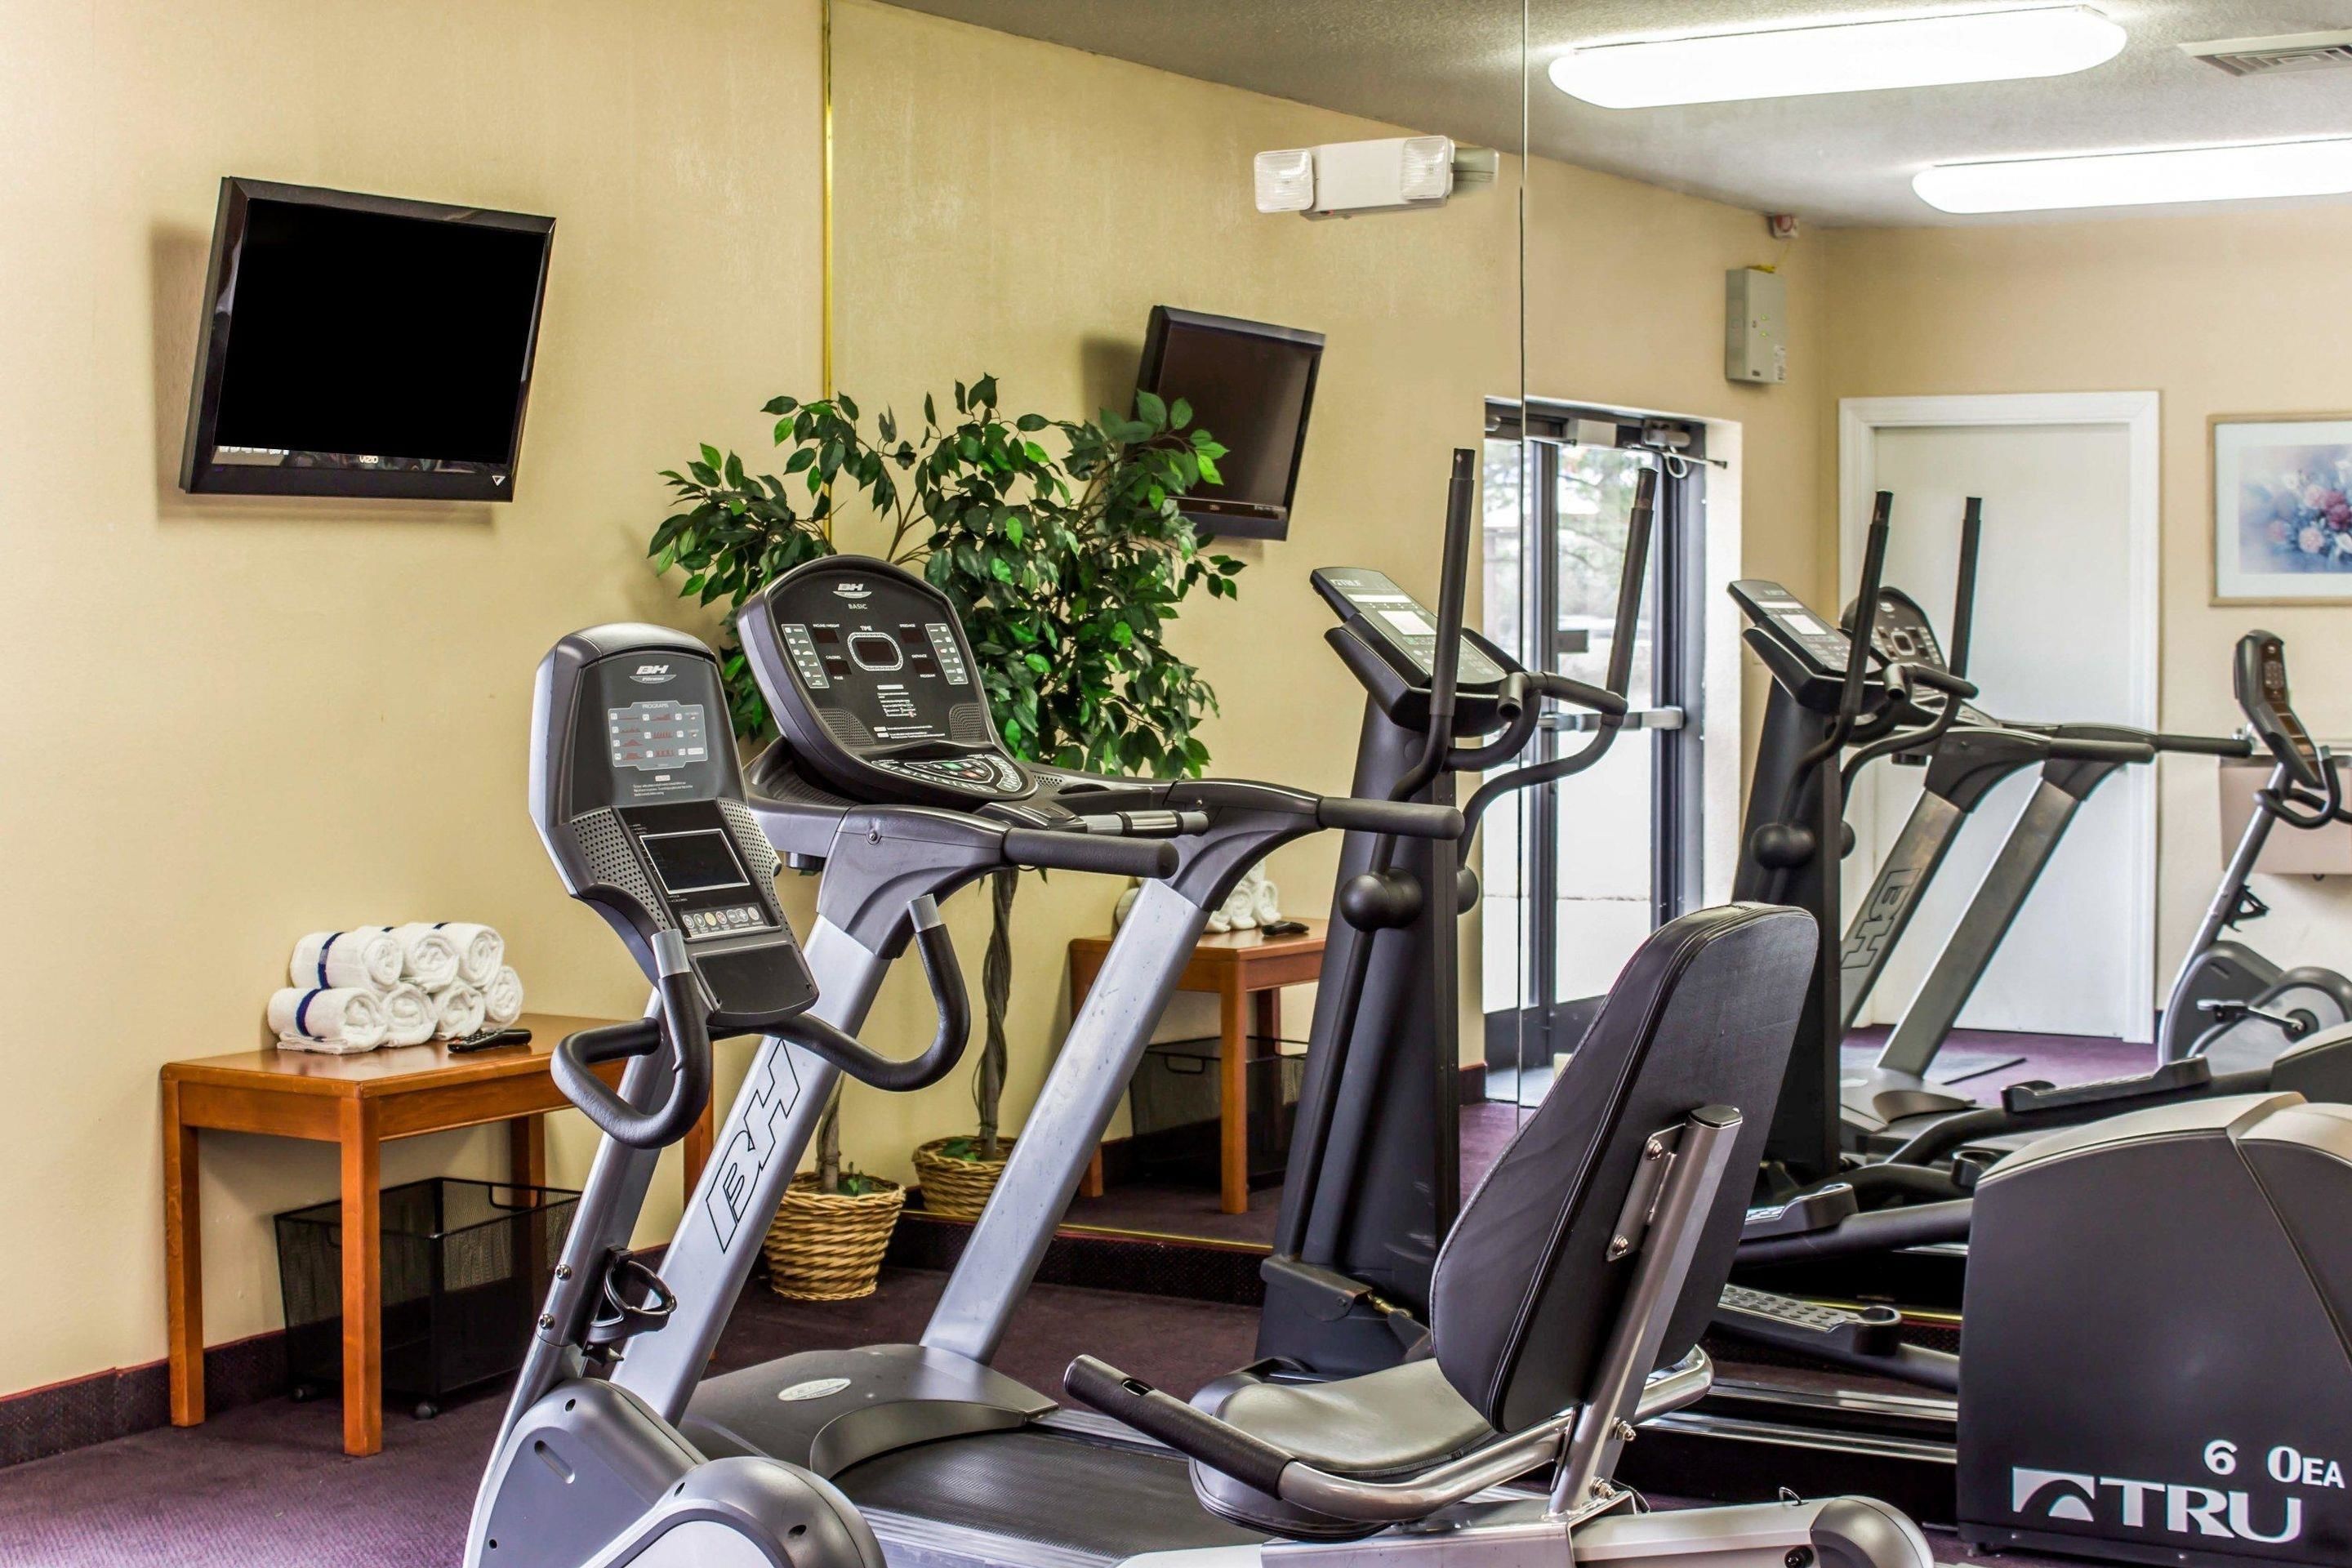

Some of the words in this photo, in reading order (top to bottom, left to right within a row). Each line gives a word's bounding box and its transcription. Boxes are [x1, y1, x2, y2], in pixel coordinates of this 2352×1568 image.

[359, 455, 378, 464] VIZIO
[837, 583, 864, 591] BH
[635, 665, 669, 675] BH
[706, 1039, 800, 1254] BH
[2204, 1439, 2238, 1476] 6
